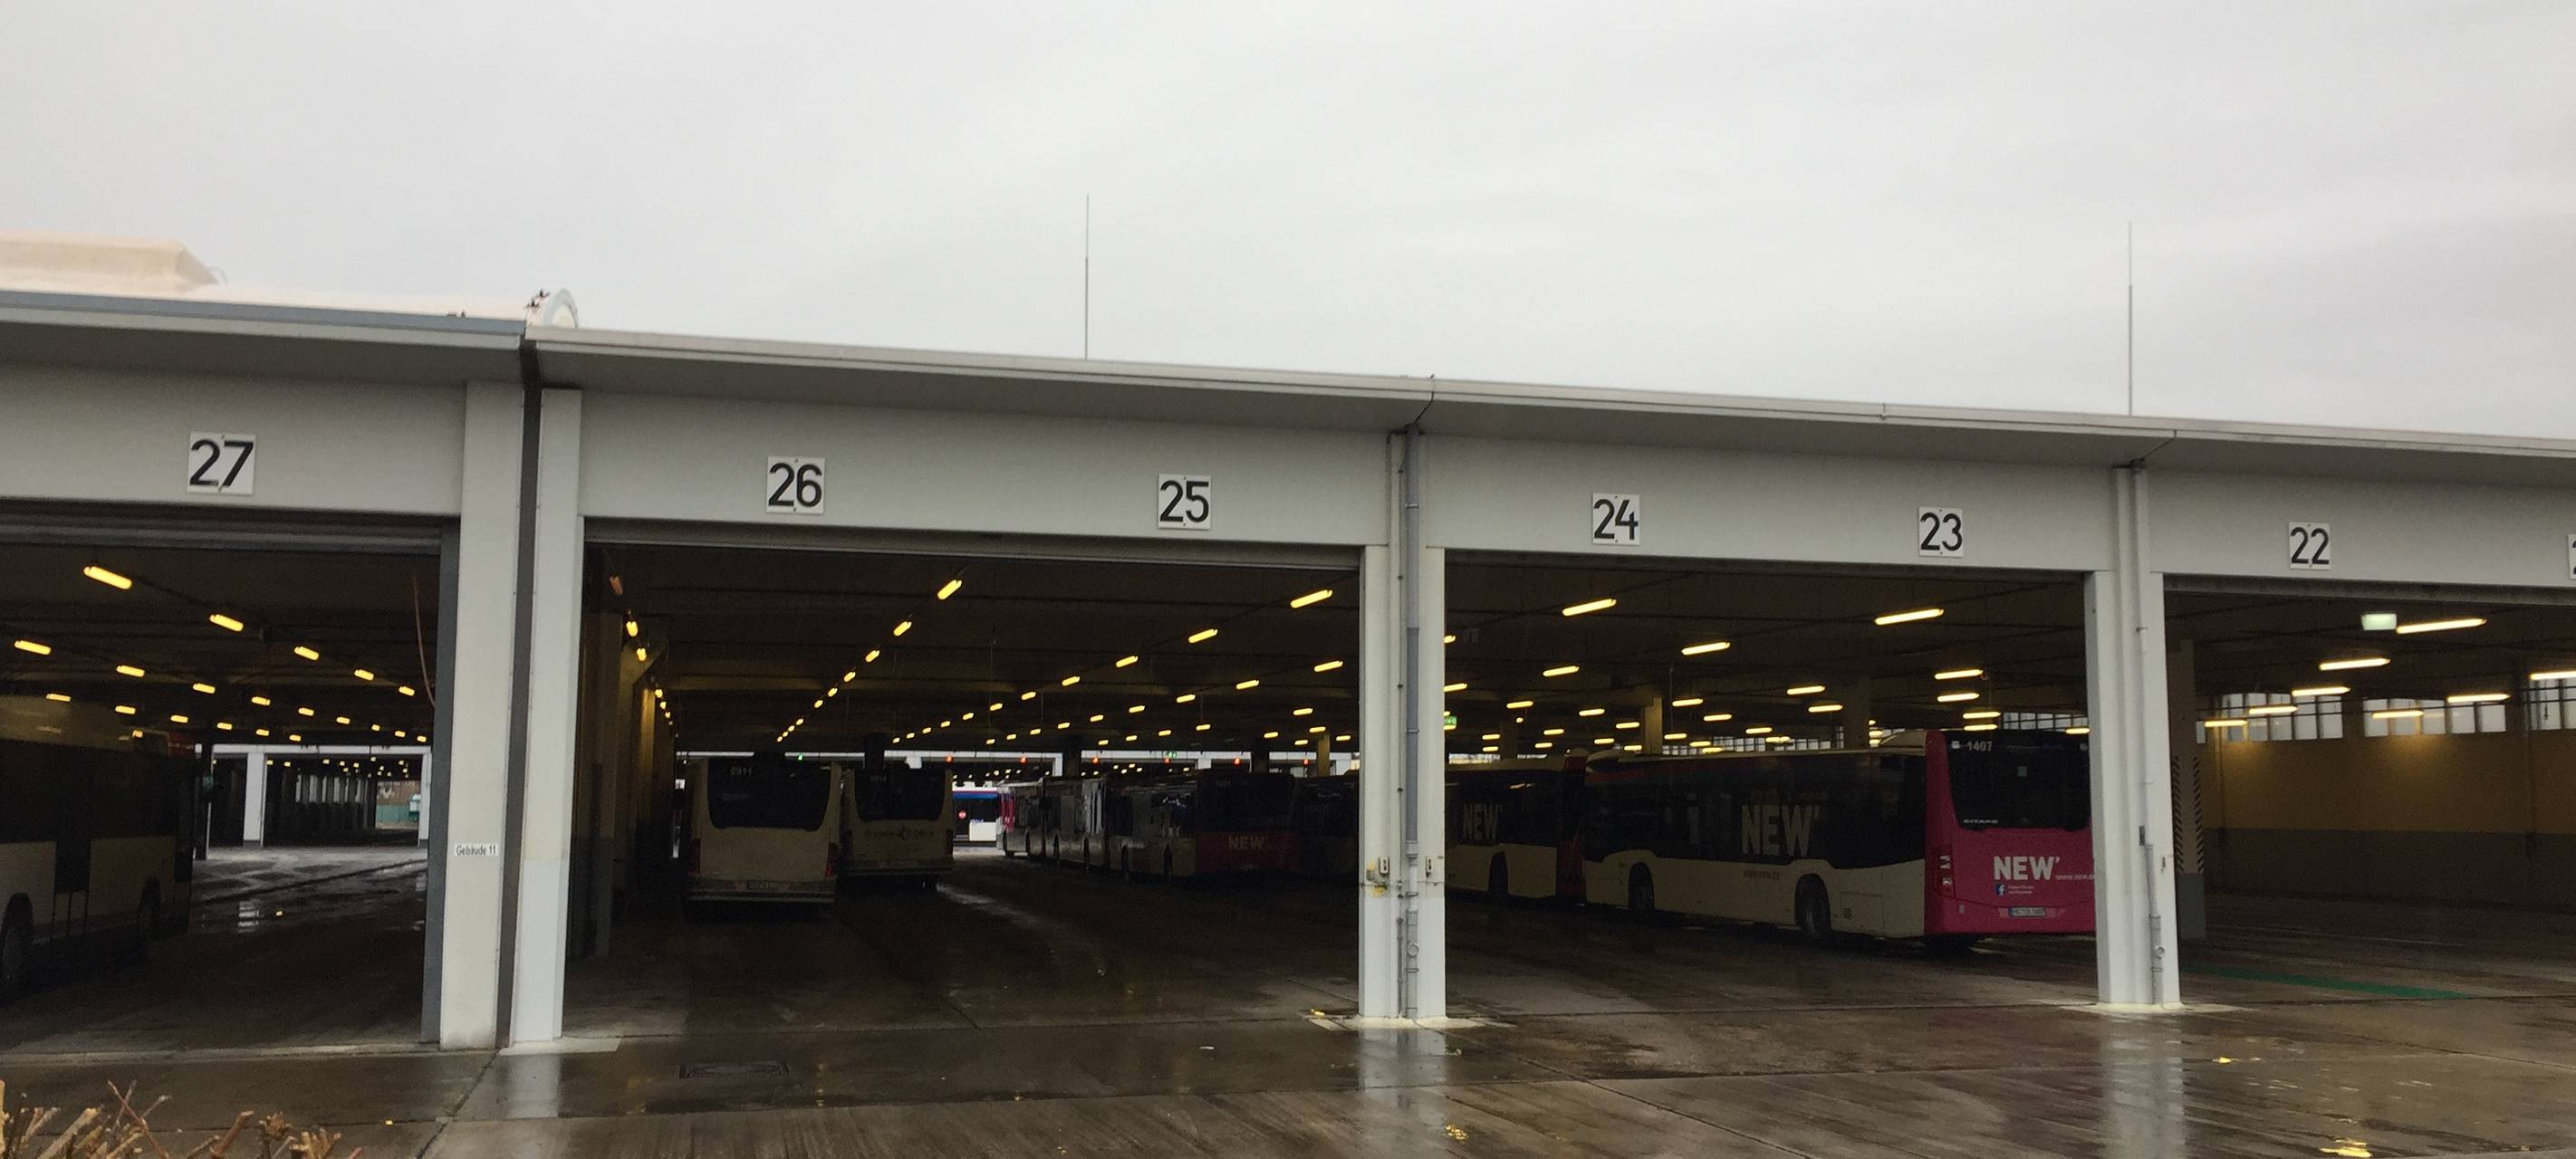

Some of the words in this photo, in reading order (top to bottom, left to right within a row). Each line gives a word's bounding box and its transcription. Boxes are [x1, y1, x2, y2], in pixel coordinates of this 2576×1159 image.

[189, 439, 254, 486] 27
[768, 463, 822, 507] 26
[1159, 480, 1209, 522] 25
[1593, 499, 1639, 540] 24
[1920, 512, 1963, 551] 23
[2291, 527, 2330, 565] 22
[1966, 741, 1993, 752] 1407
